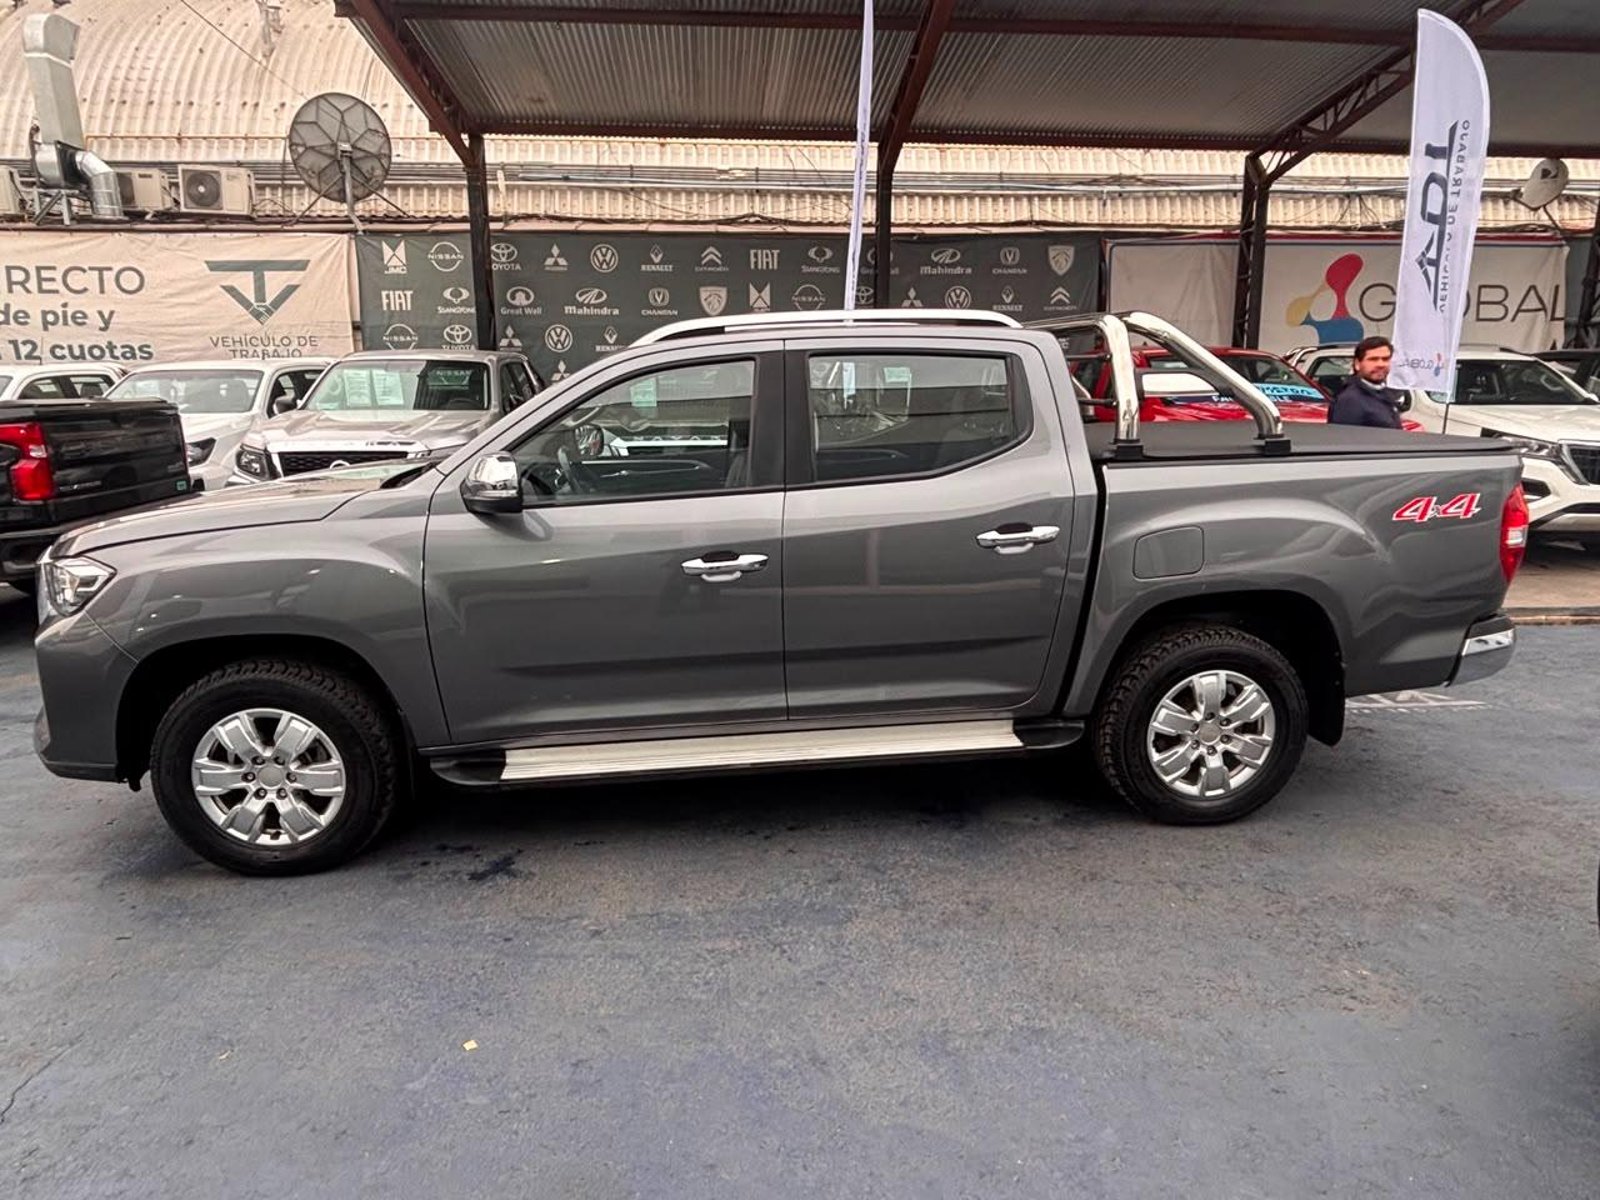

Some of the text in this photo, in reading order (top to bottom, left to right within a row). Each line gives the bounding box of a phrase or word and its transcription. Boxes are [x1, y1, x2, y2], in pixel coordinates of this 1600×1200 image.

[491, 263, 522, 271] OYOTA
[750, 249, 780, 270] FIAT
[384, 266, 408, 275] JMC
[919, 265, 973, 275] Mahindra
[4, 265, 146, 295] RECTO
[380, 290, 414, 311] FIAT
[1358, 282, 1565, 323] GBAL
[0, 302, 31, 326] de
[97, 309, 116, 332] y
[500, 306, 543, 316] Great Wall
[563, 305, 621, 316] Mahindra
[297, 335, 319, 347] DE
[7, 339, 155, 361] 12 cuotas
[228, 348, 303, 360] TRABAJO
[1392, 492, 1482, 523] 4x4
